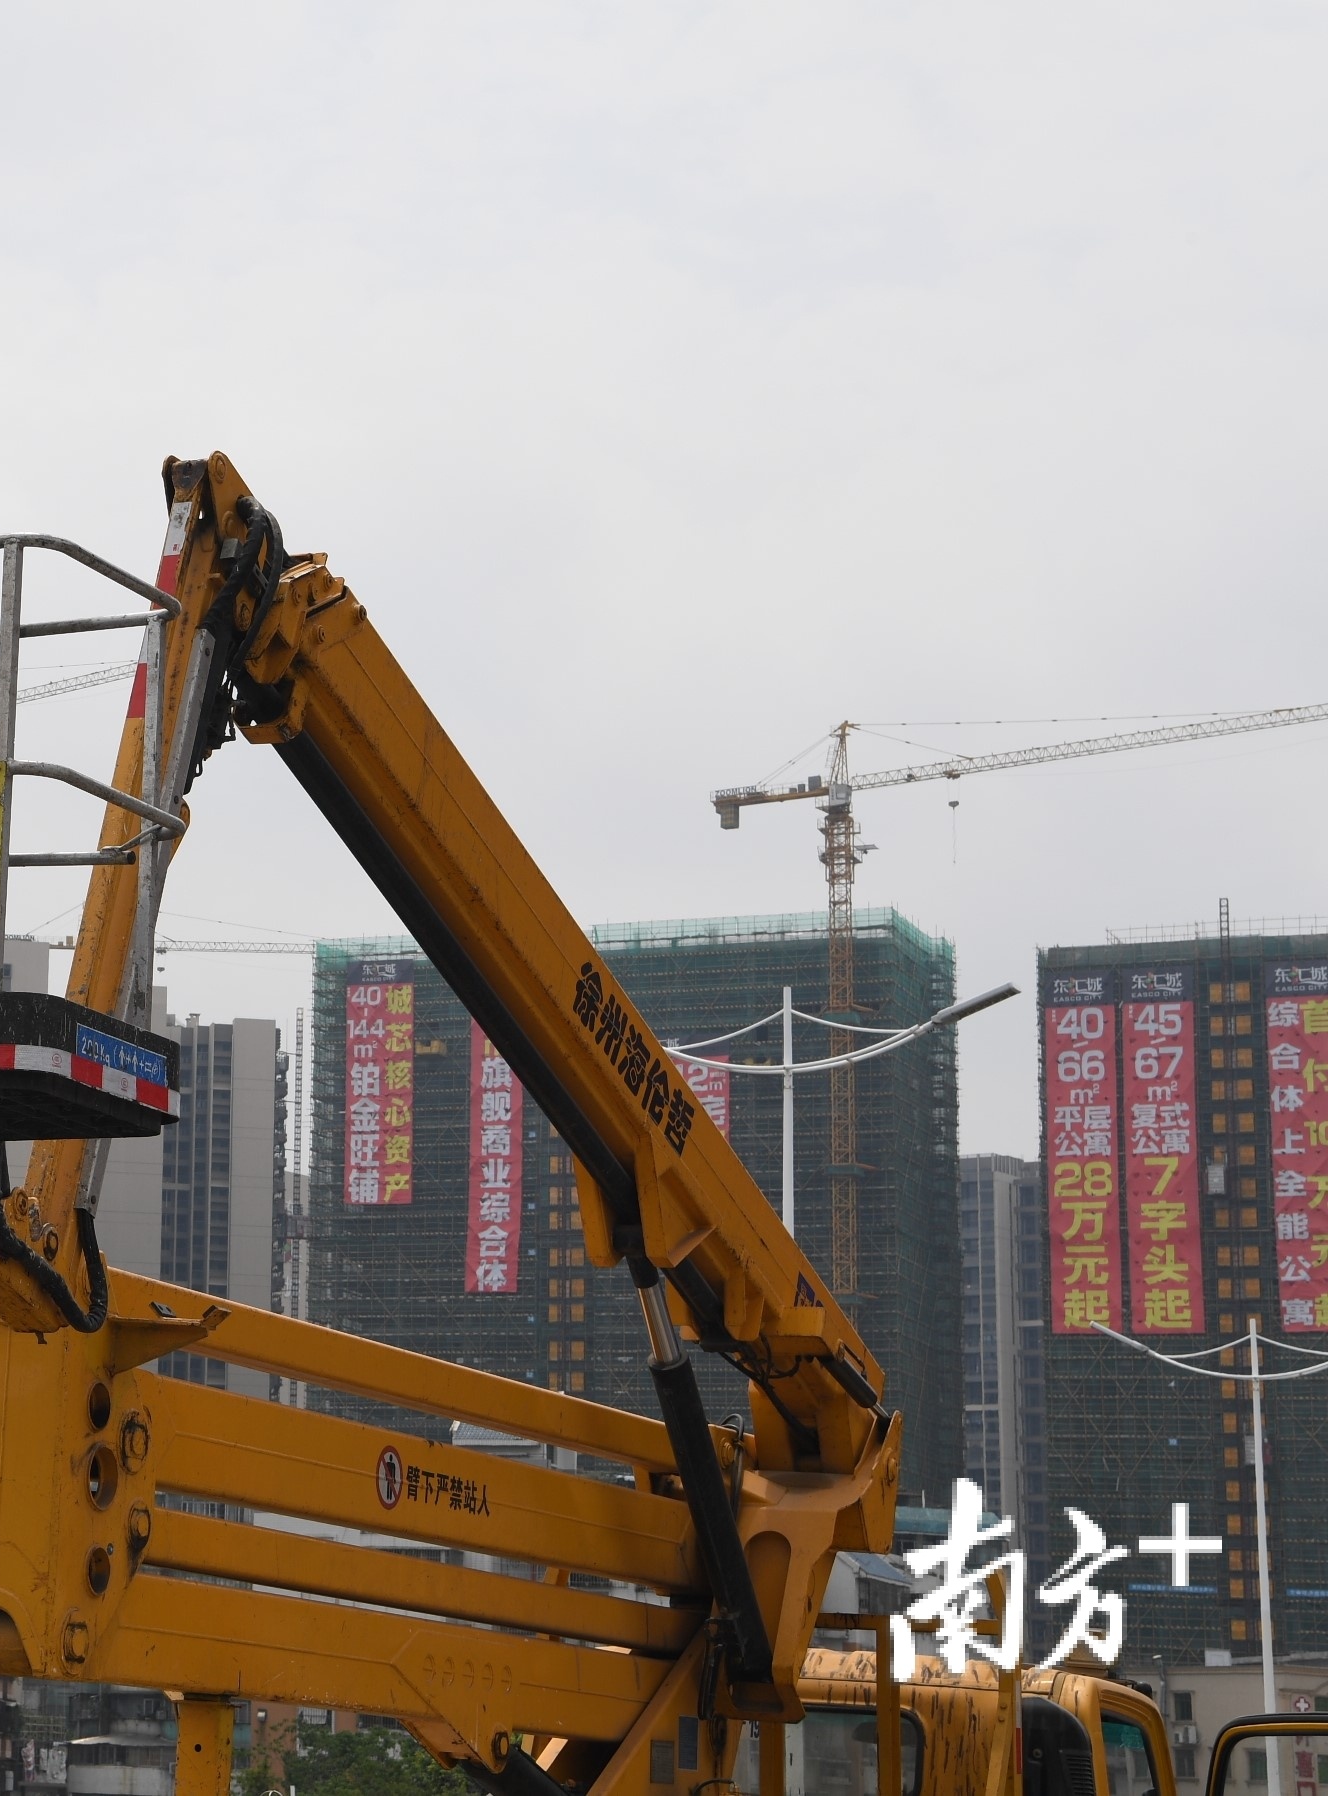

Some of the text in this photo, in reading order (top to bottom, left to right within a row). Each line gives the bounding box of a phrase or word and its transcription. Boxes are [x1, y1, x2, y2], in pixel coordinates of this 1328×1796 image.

[715, 786, 757, 797] ZOOMLION
[1054, 976, 1103, 994] 东汇城
[1131, 972, 1183, 990] 东汇城
[1275, 966, 1328, 984] 东汇城
[573, 961, 695, 1157] 徐州海伦哲
[383, 984, 412, 1203] 城芯核心资产
[1268, 1001, 1314, 1326] 综合体上全能公寓
[406, 1465, 490, 1517] 臂下严禁站人
